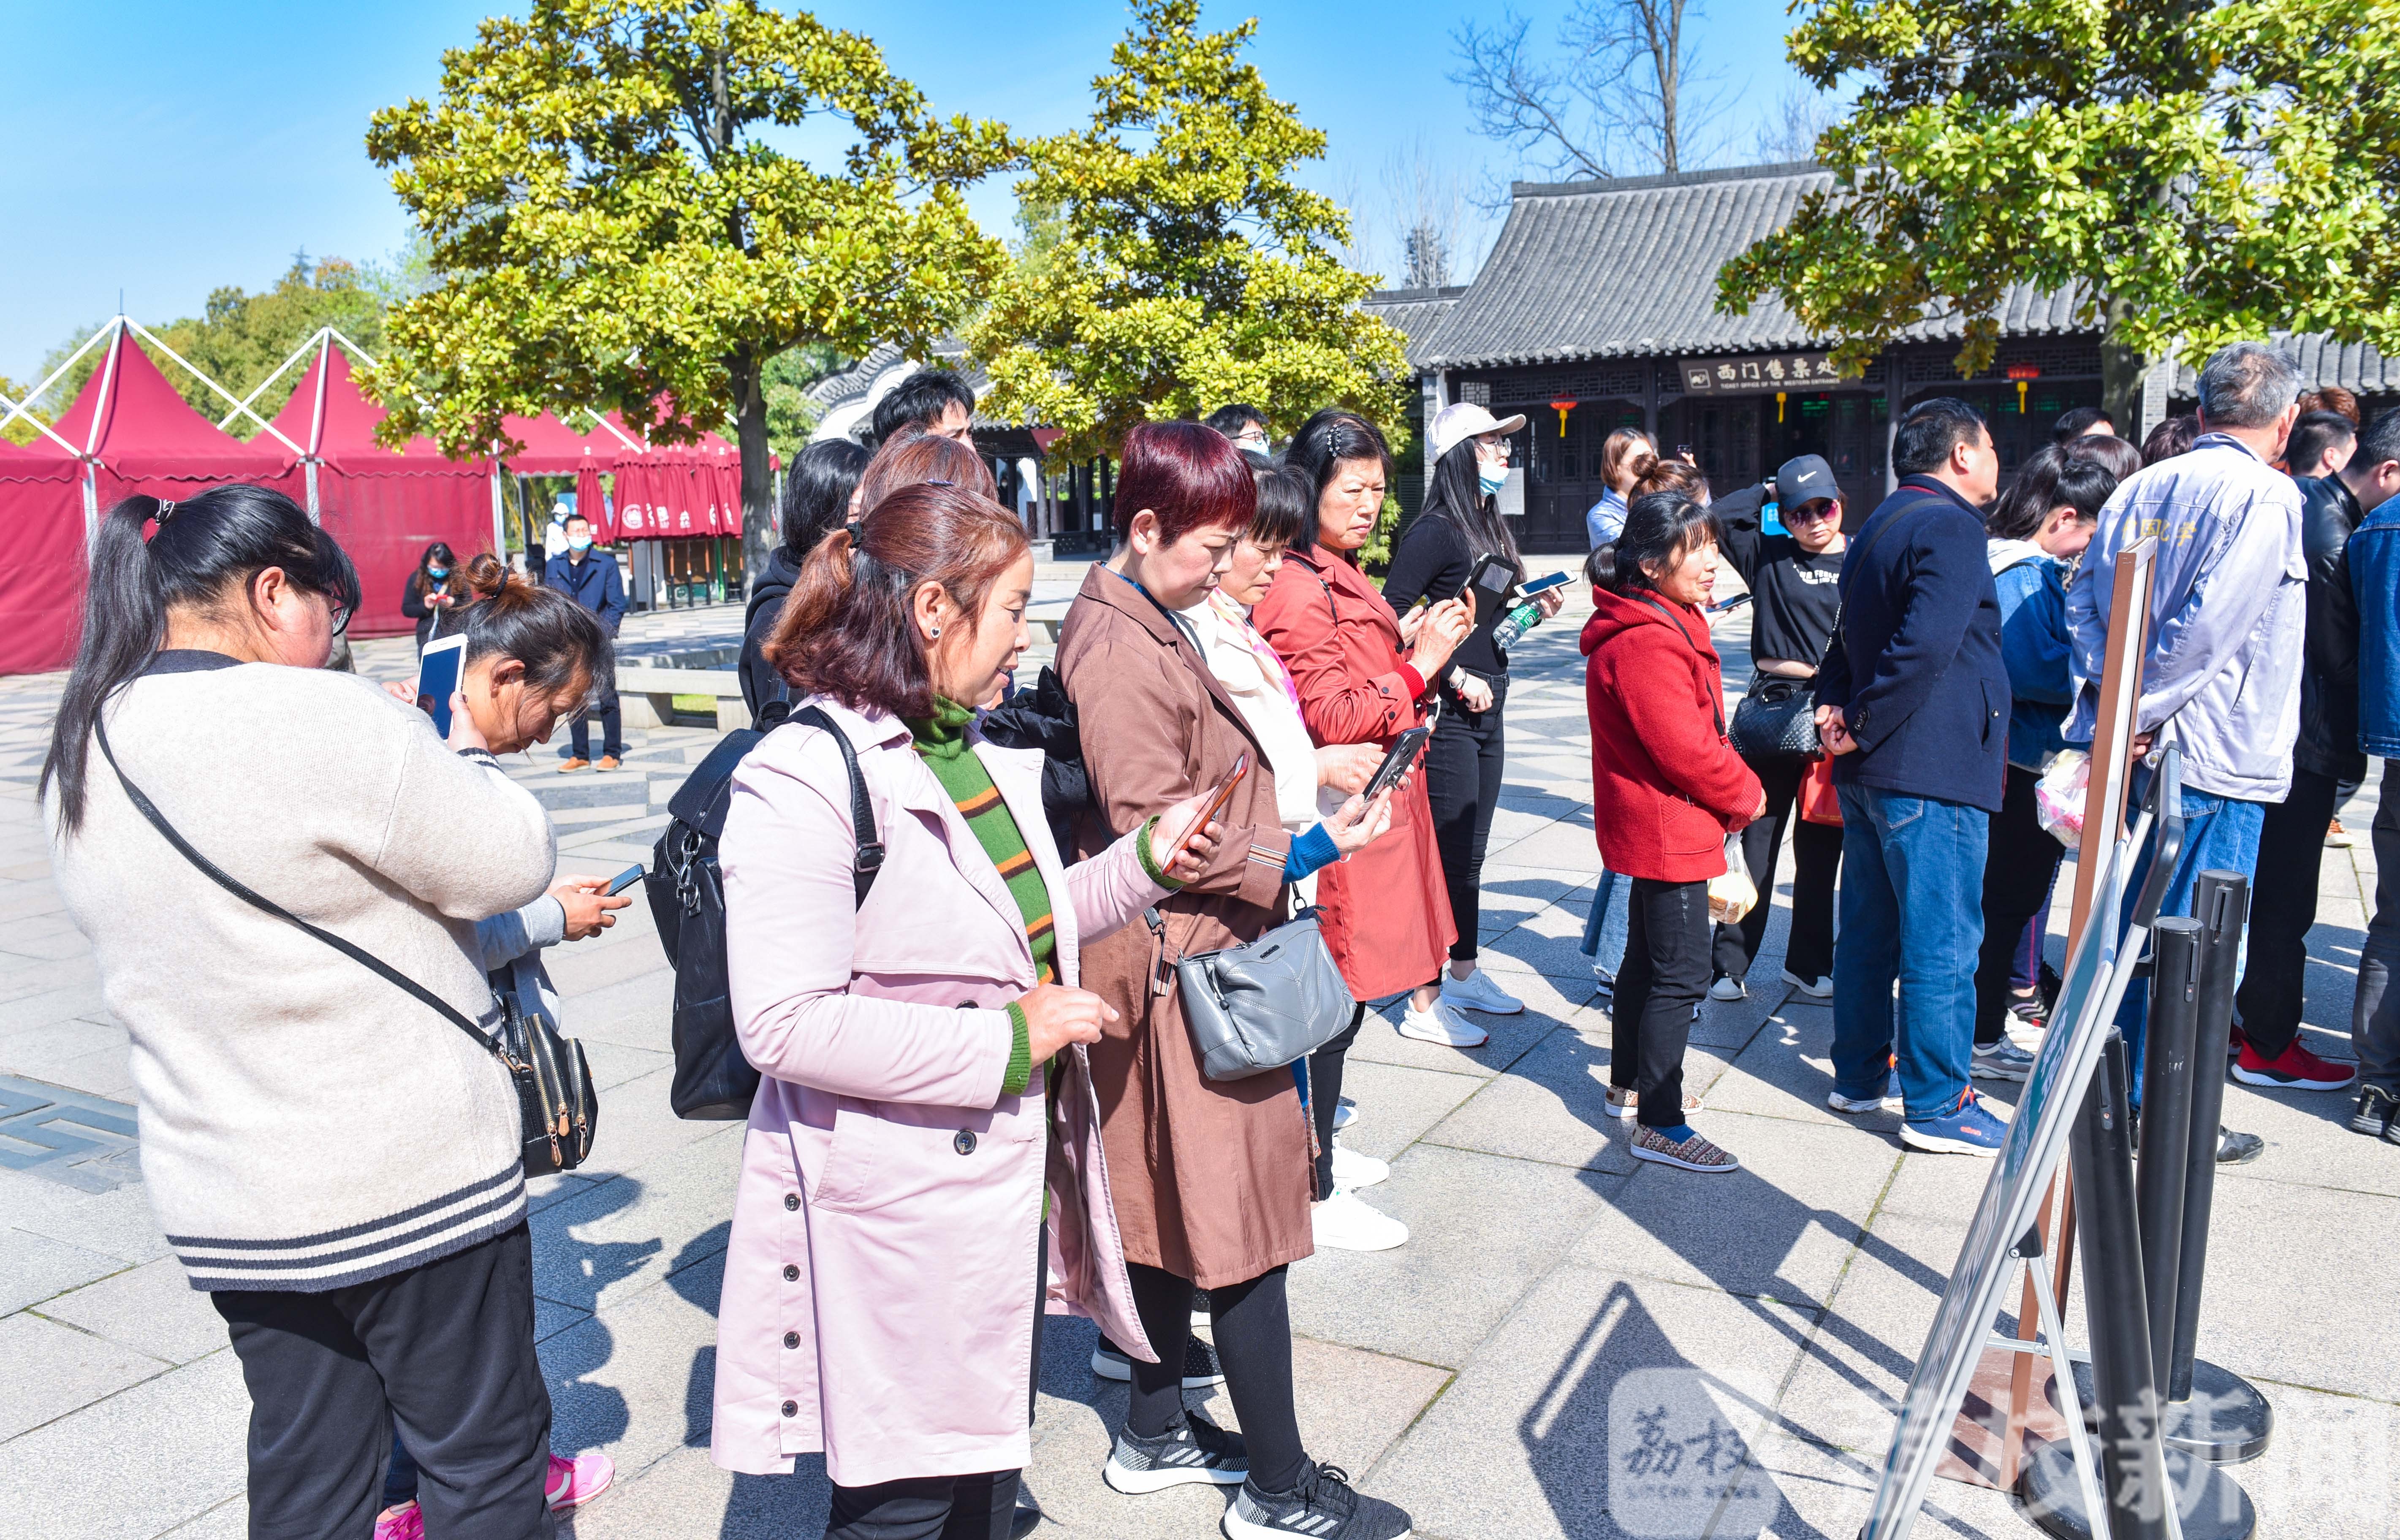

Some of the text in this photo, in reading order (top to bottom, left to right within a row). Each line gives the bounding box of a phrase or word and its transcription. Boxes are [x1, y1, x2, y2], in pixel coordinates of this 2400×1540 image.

[1717, 358, 1838, 380] 西门售票处
